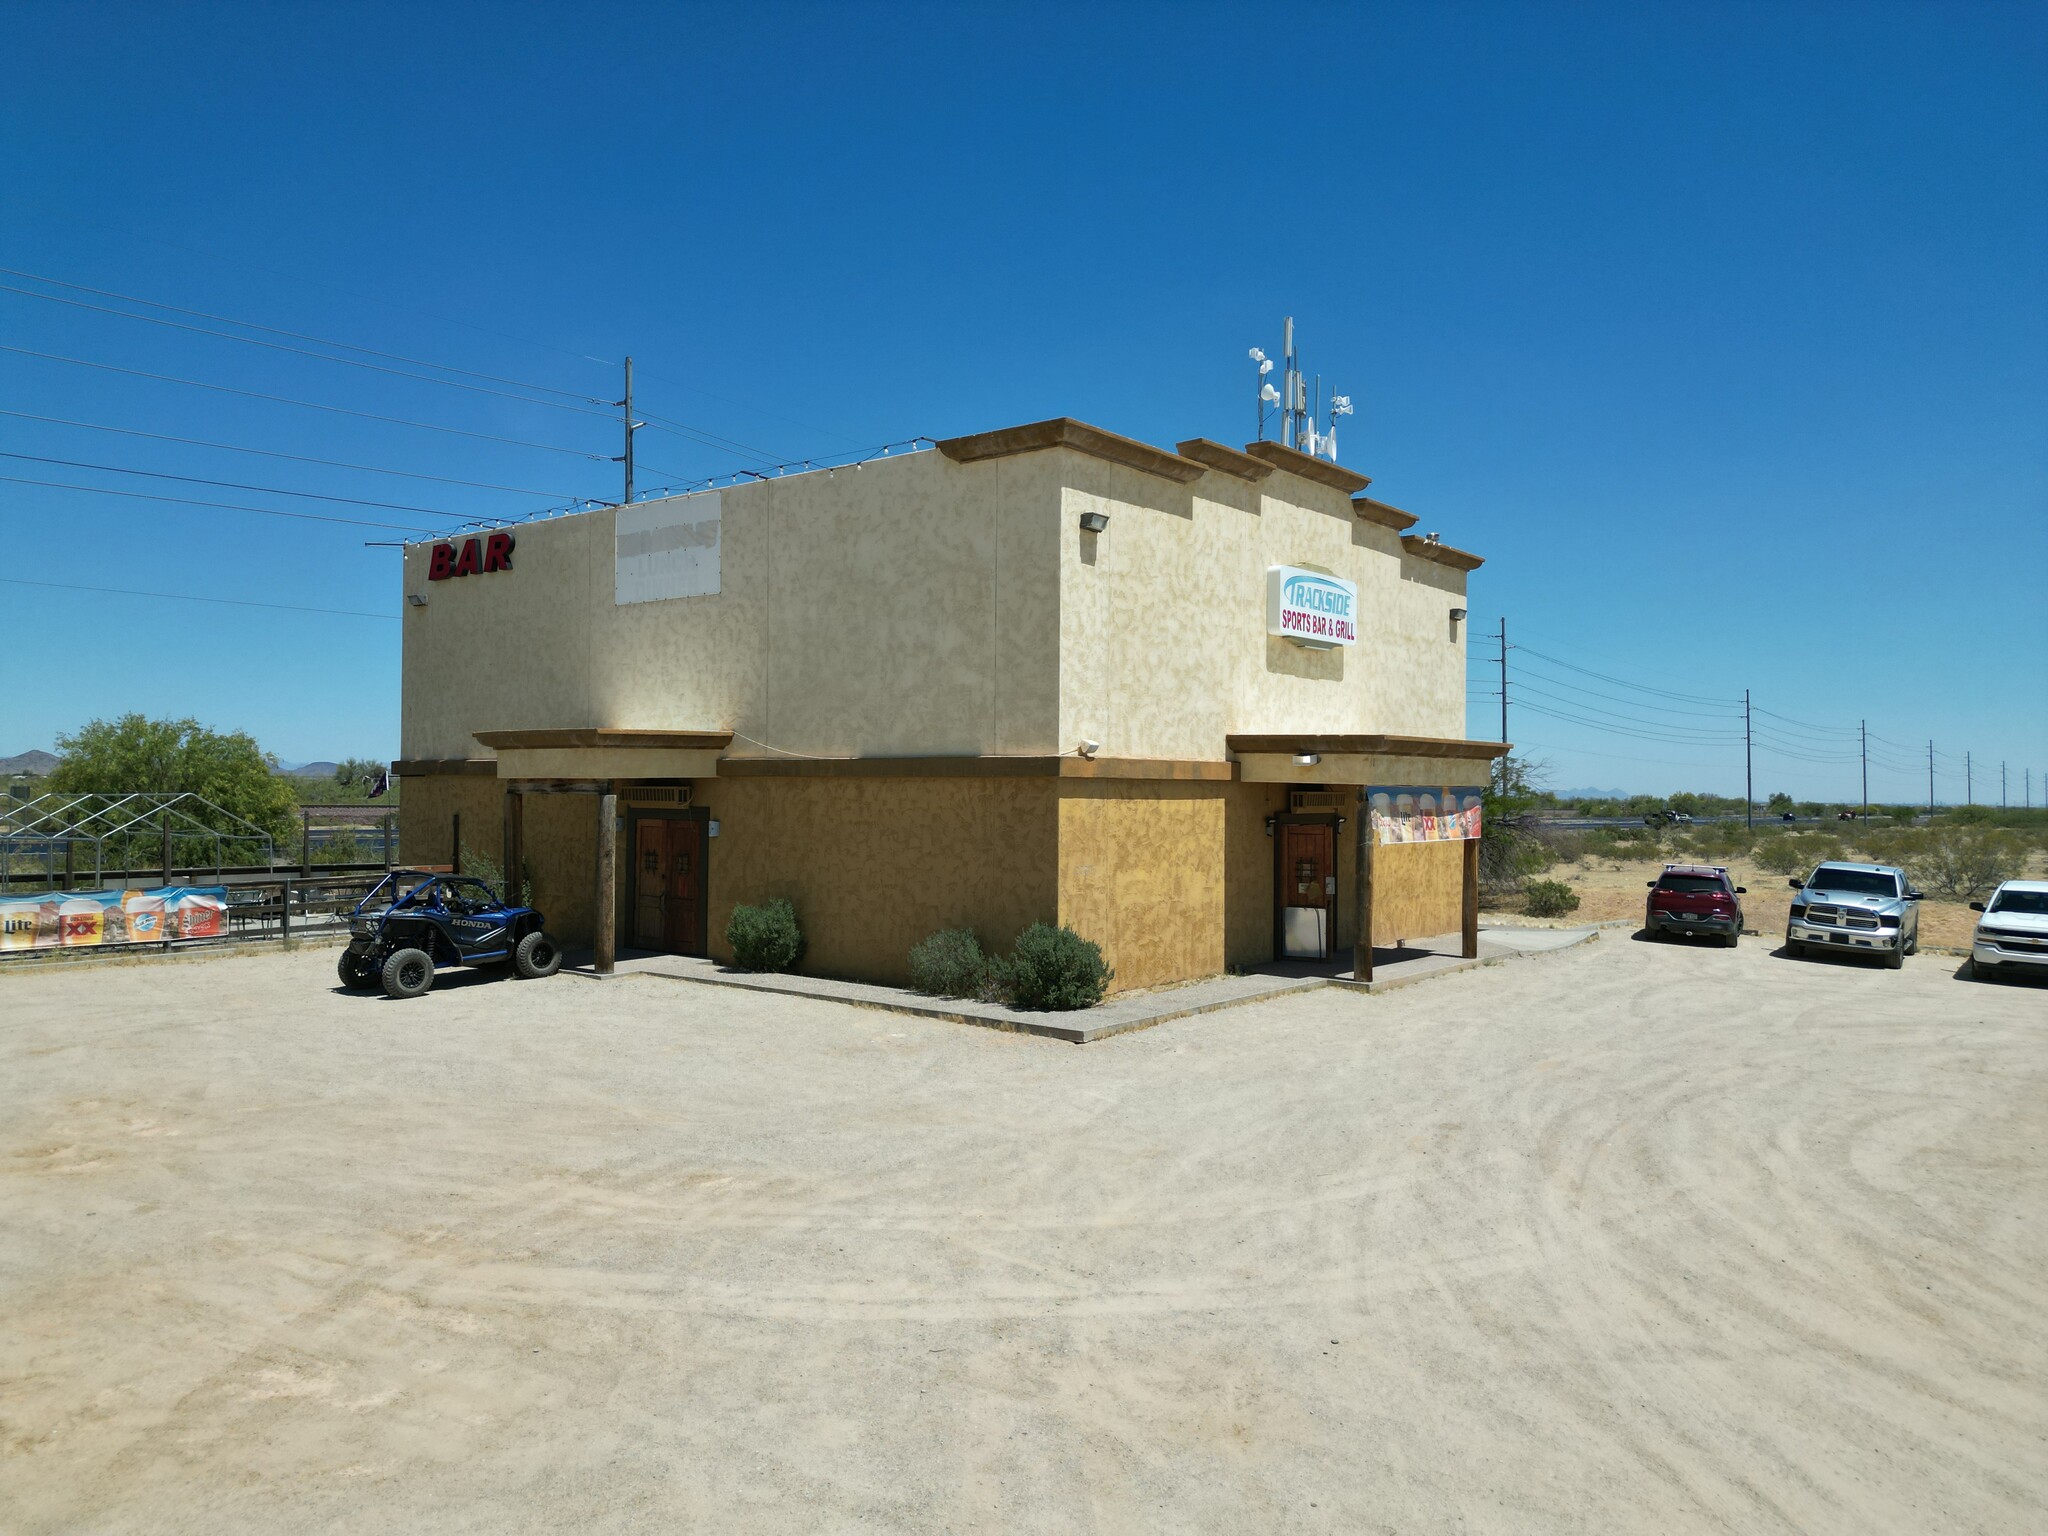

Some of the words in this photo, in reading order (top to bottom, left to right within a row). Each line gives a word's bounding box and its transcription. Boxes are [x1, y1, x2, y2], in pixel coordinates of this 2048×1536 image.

[428, 533, 516, 581] BAR
[1286, 578, 1350, 617] TRACKSIDE
[1282, 609, 1311, 632] SPORTS
[1312, 614, 1327, 635] BAR
[1328, 618, 1334, 636] &
[1335, 620, 1355, 641] GRILL
[1423, 817, 1436, 831] XX
[5, 919, 32, 935] Lite
[66, 921, 97, 937] XX
[451, 918, 492, 930] HONDA
